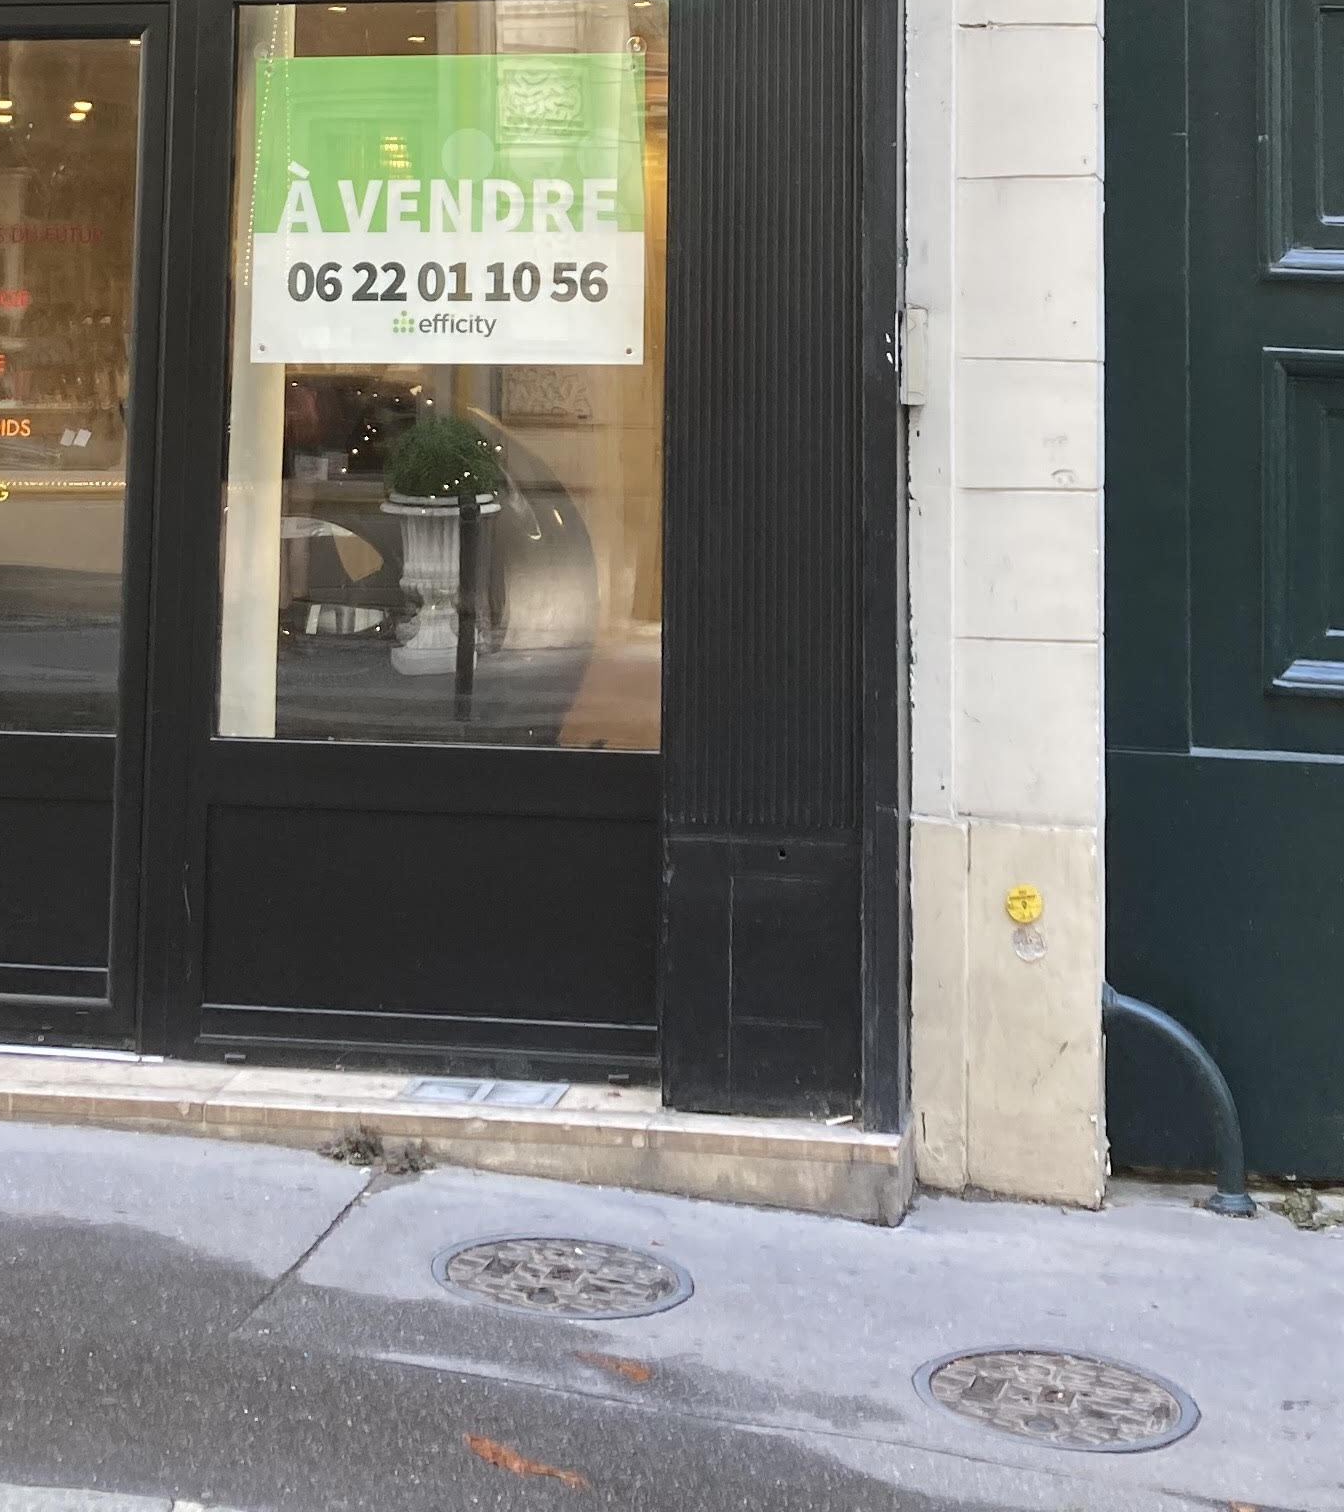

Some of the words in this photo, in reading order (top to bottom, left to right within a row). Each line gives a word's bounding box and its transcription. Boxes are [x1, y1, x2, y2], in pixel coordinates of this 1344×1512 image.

[276, 160, 324, 234] À
[338, 178, 619, 234] VENDRE
[287, 261, 343, 303] 06
[351, 261, 407, 302] 22
[417, 261, 473, 303] 01
[485, 261, 541, 303] 10
[550, 261, 609, 303] 56
[418, 312, 497, 337] efficity
